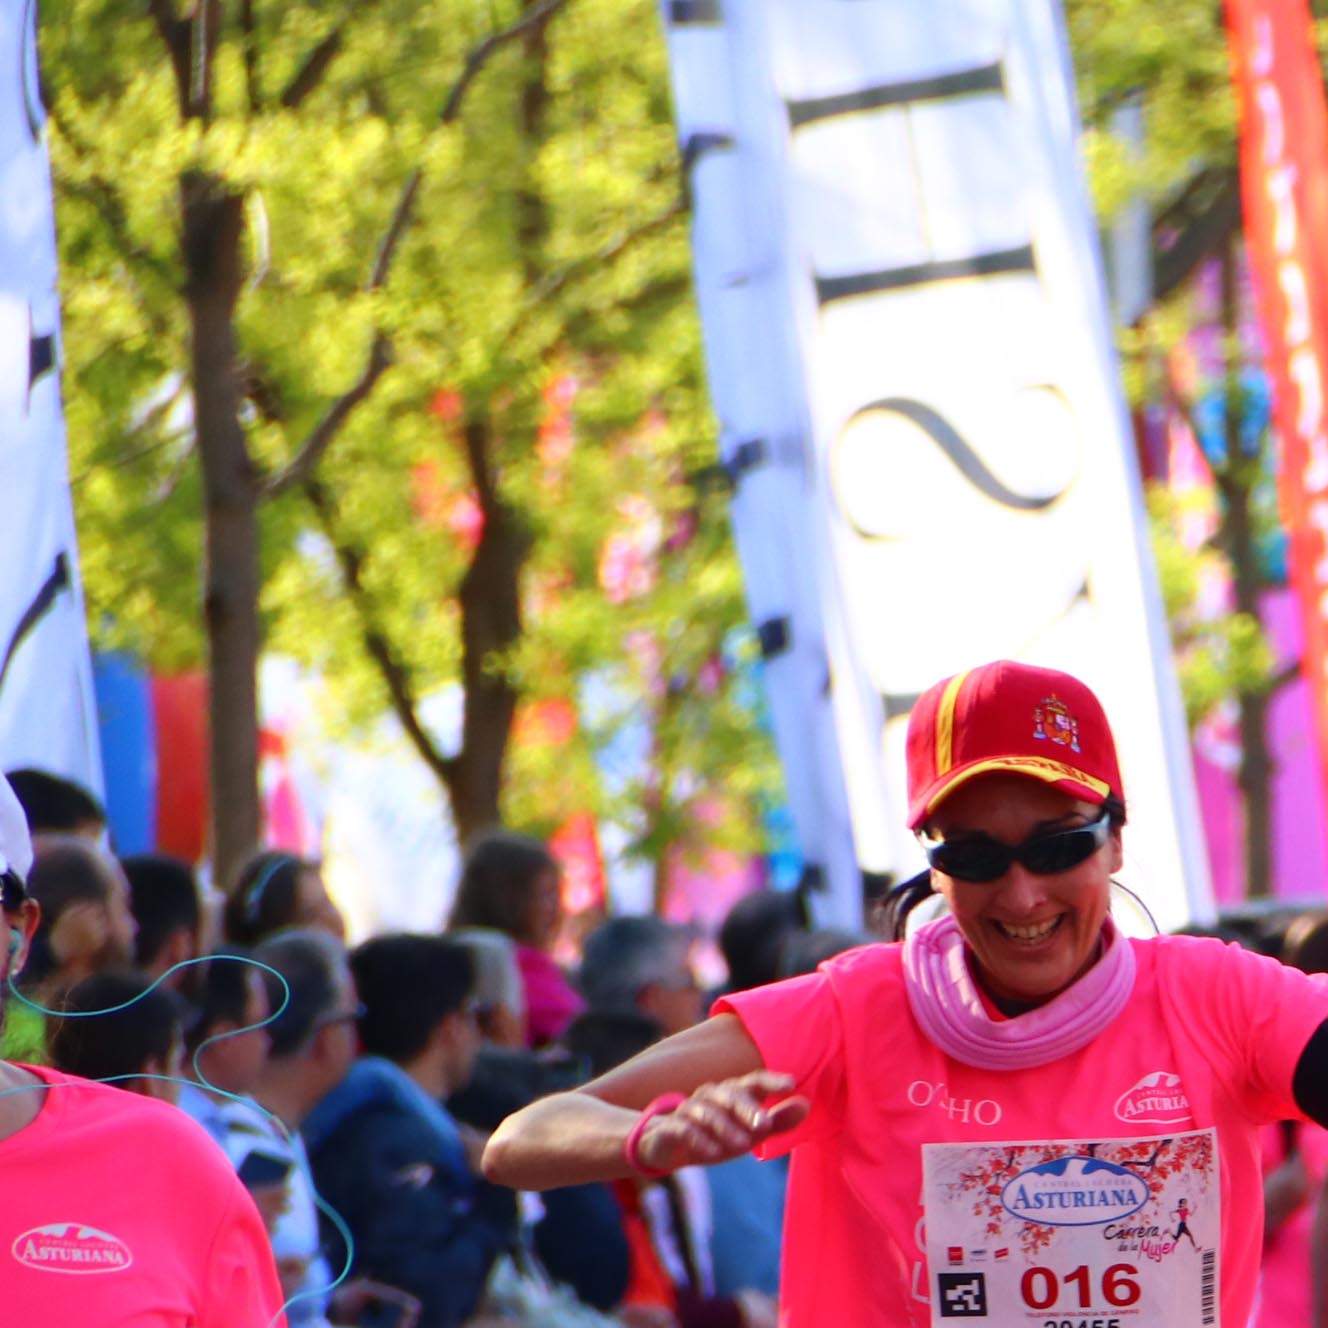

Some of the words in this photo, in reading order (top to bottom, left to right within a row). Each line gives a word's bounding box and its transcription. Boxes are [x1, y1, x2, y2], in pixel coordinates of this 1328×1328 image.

[1012, 1183, 1139, 1210] ASTURIANA
[22, 1238, 125, 1265] ASTURIANA
[1020, 1263, 1142, 1310] 016
